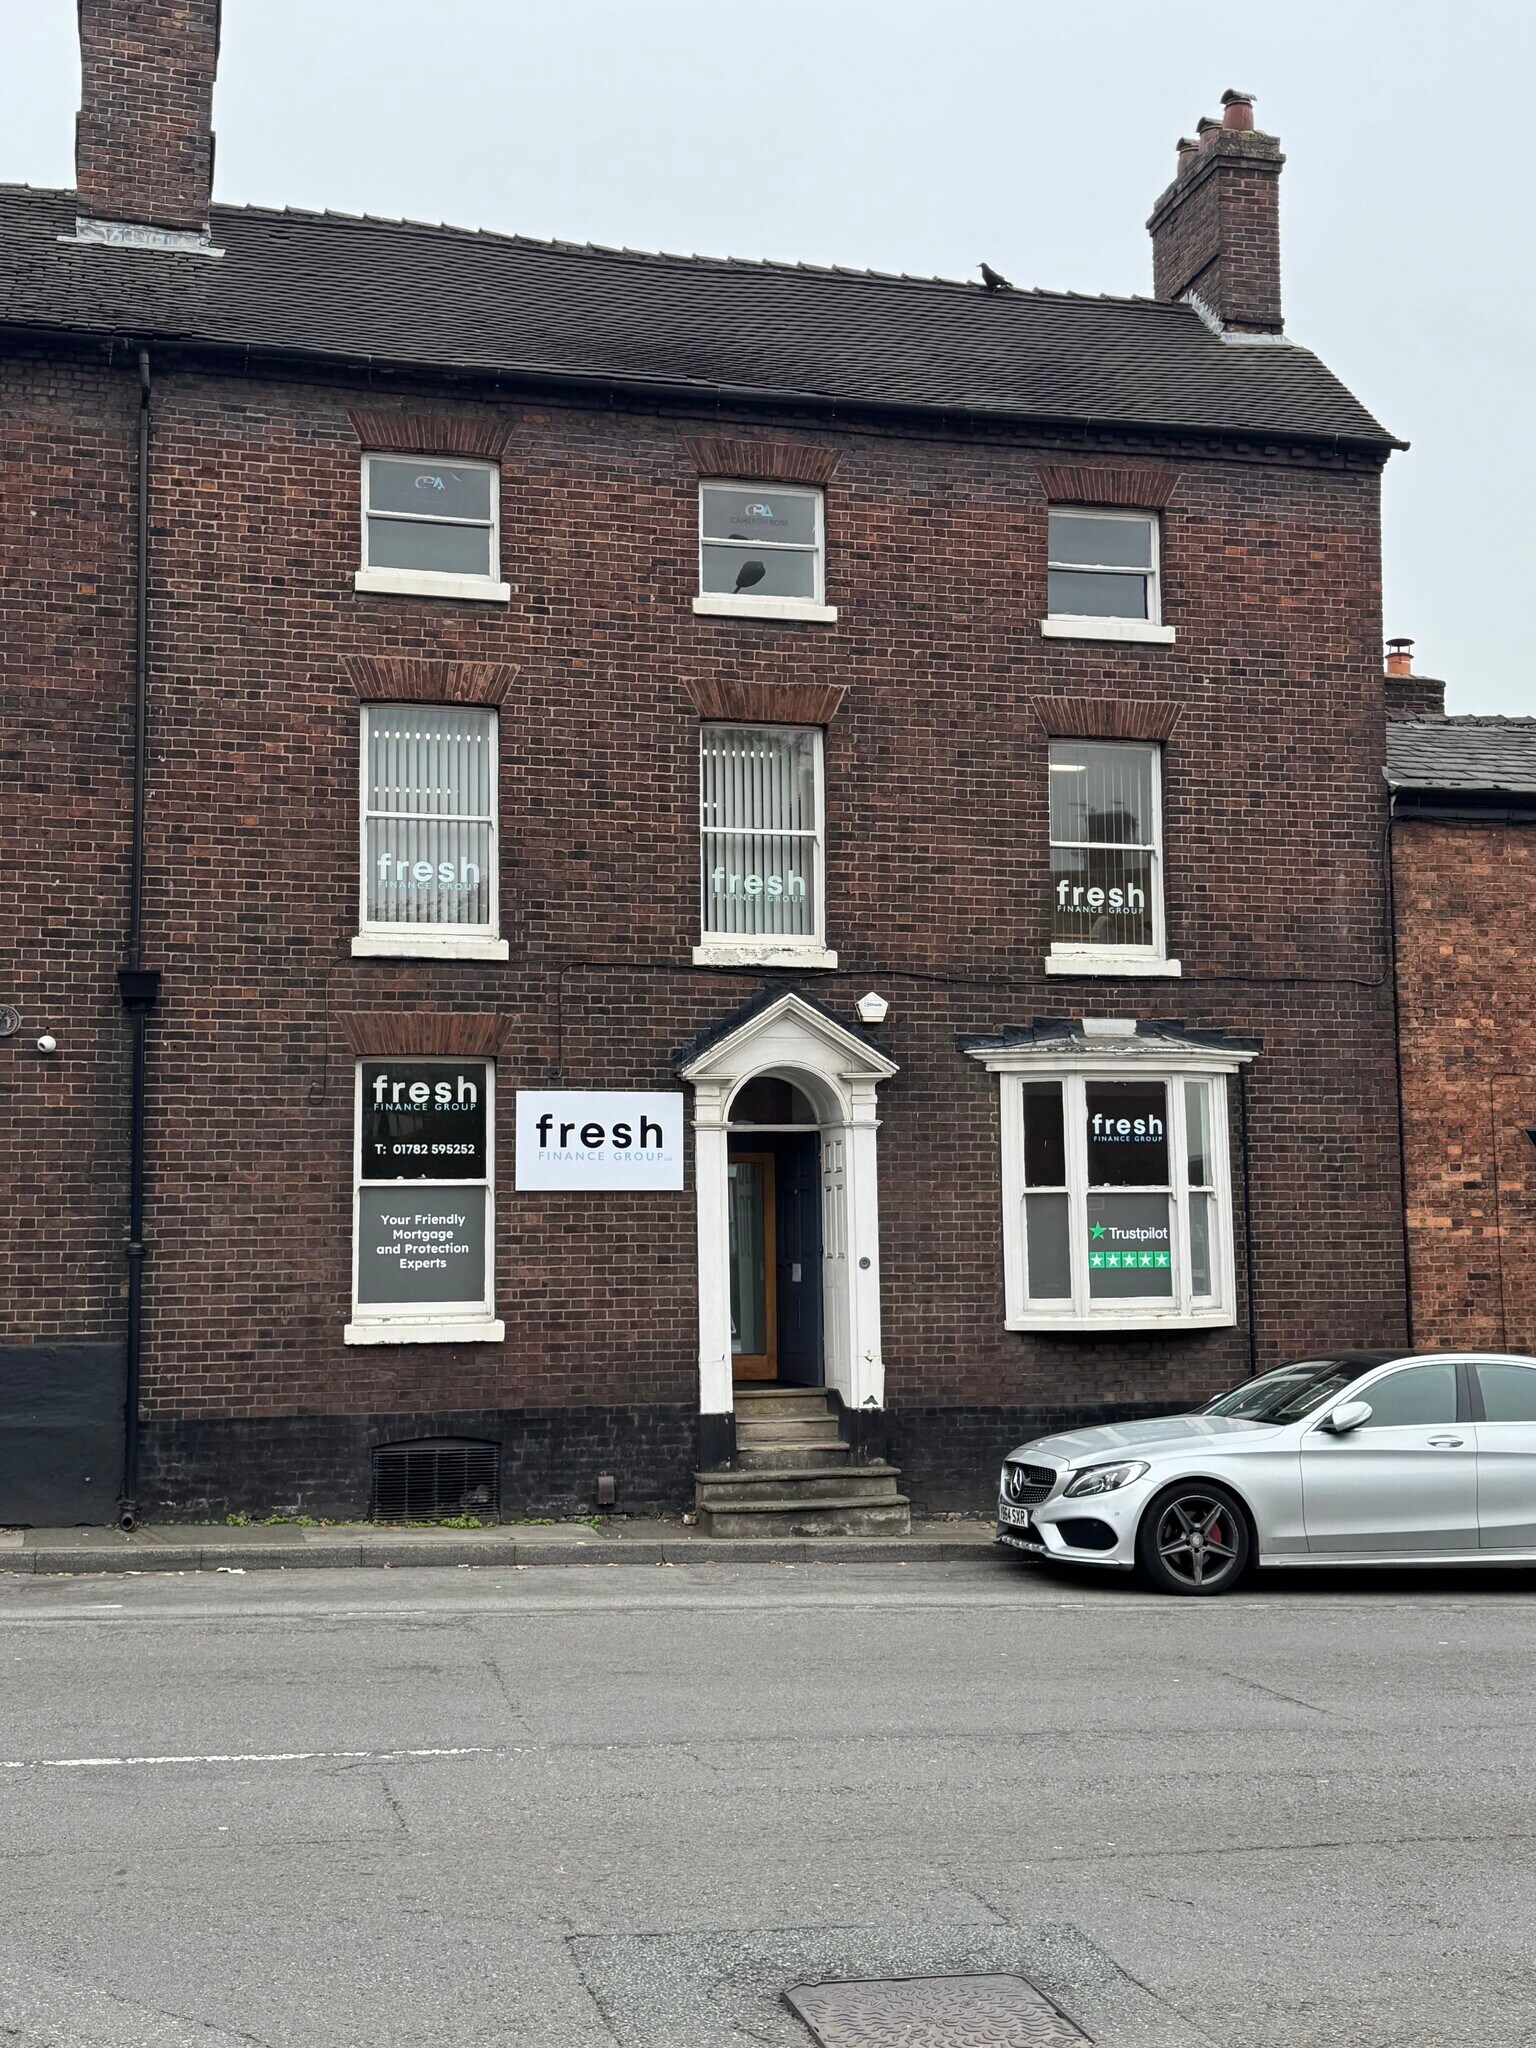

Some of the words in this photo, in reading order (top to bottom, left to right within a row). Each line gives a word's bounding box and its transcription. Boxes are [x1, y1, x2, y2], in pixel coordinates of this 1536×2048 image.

[377, 852, 480, 884] fresh
[377, 880, 432, 890] FINANCE
[438, 882, 479, 891] GROUP
[711, 866, 806, 896] fresh
[712, 893, 761, 902] FINANCE
[767, 895, 805, 903] GROUP
[1056, 879, 1145, 908] fresh
[1057, 905, 1103, 914] FINANCE
[1108, 906, 1144, 915] GROUP
[372, 1074, 477, 1103] fresh
[373, 1103, 428, 1111] FINANCE
[434, 1103, 476, 1111] GROUP
[1092, 1113, 1163, 1135] fresh
[535, 1113, 663, 1149] fresh
[374, 1143, 387, 1155] T:
[392, 1143, 429, 1155] 01782
[431, 1143, 475, 1155] 595252
[538, 1151, 605, 1160] FINANCE
[613, 1151, 664, 1161] GROUP
[380, 1214, 412, 1225] Your
[414, 1213, 466, 1227] Friendly
[392, 1229, 454, 1242] Mortgage
[1108, 1226, 1169, 1243] Trustpilot
[376, 1243, 401, 1255] and
[404, 1242, 469, 1254] Protection
[399, 1258, 447, 1271] Experts
[1012, 1508, 1025, 1526] SXR
